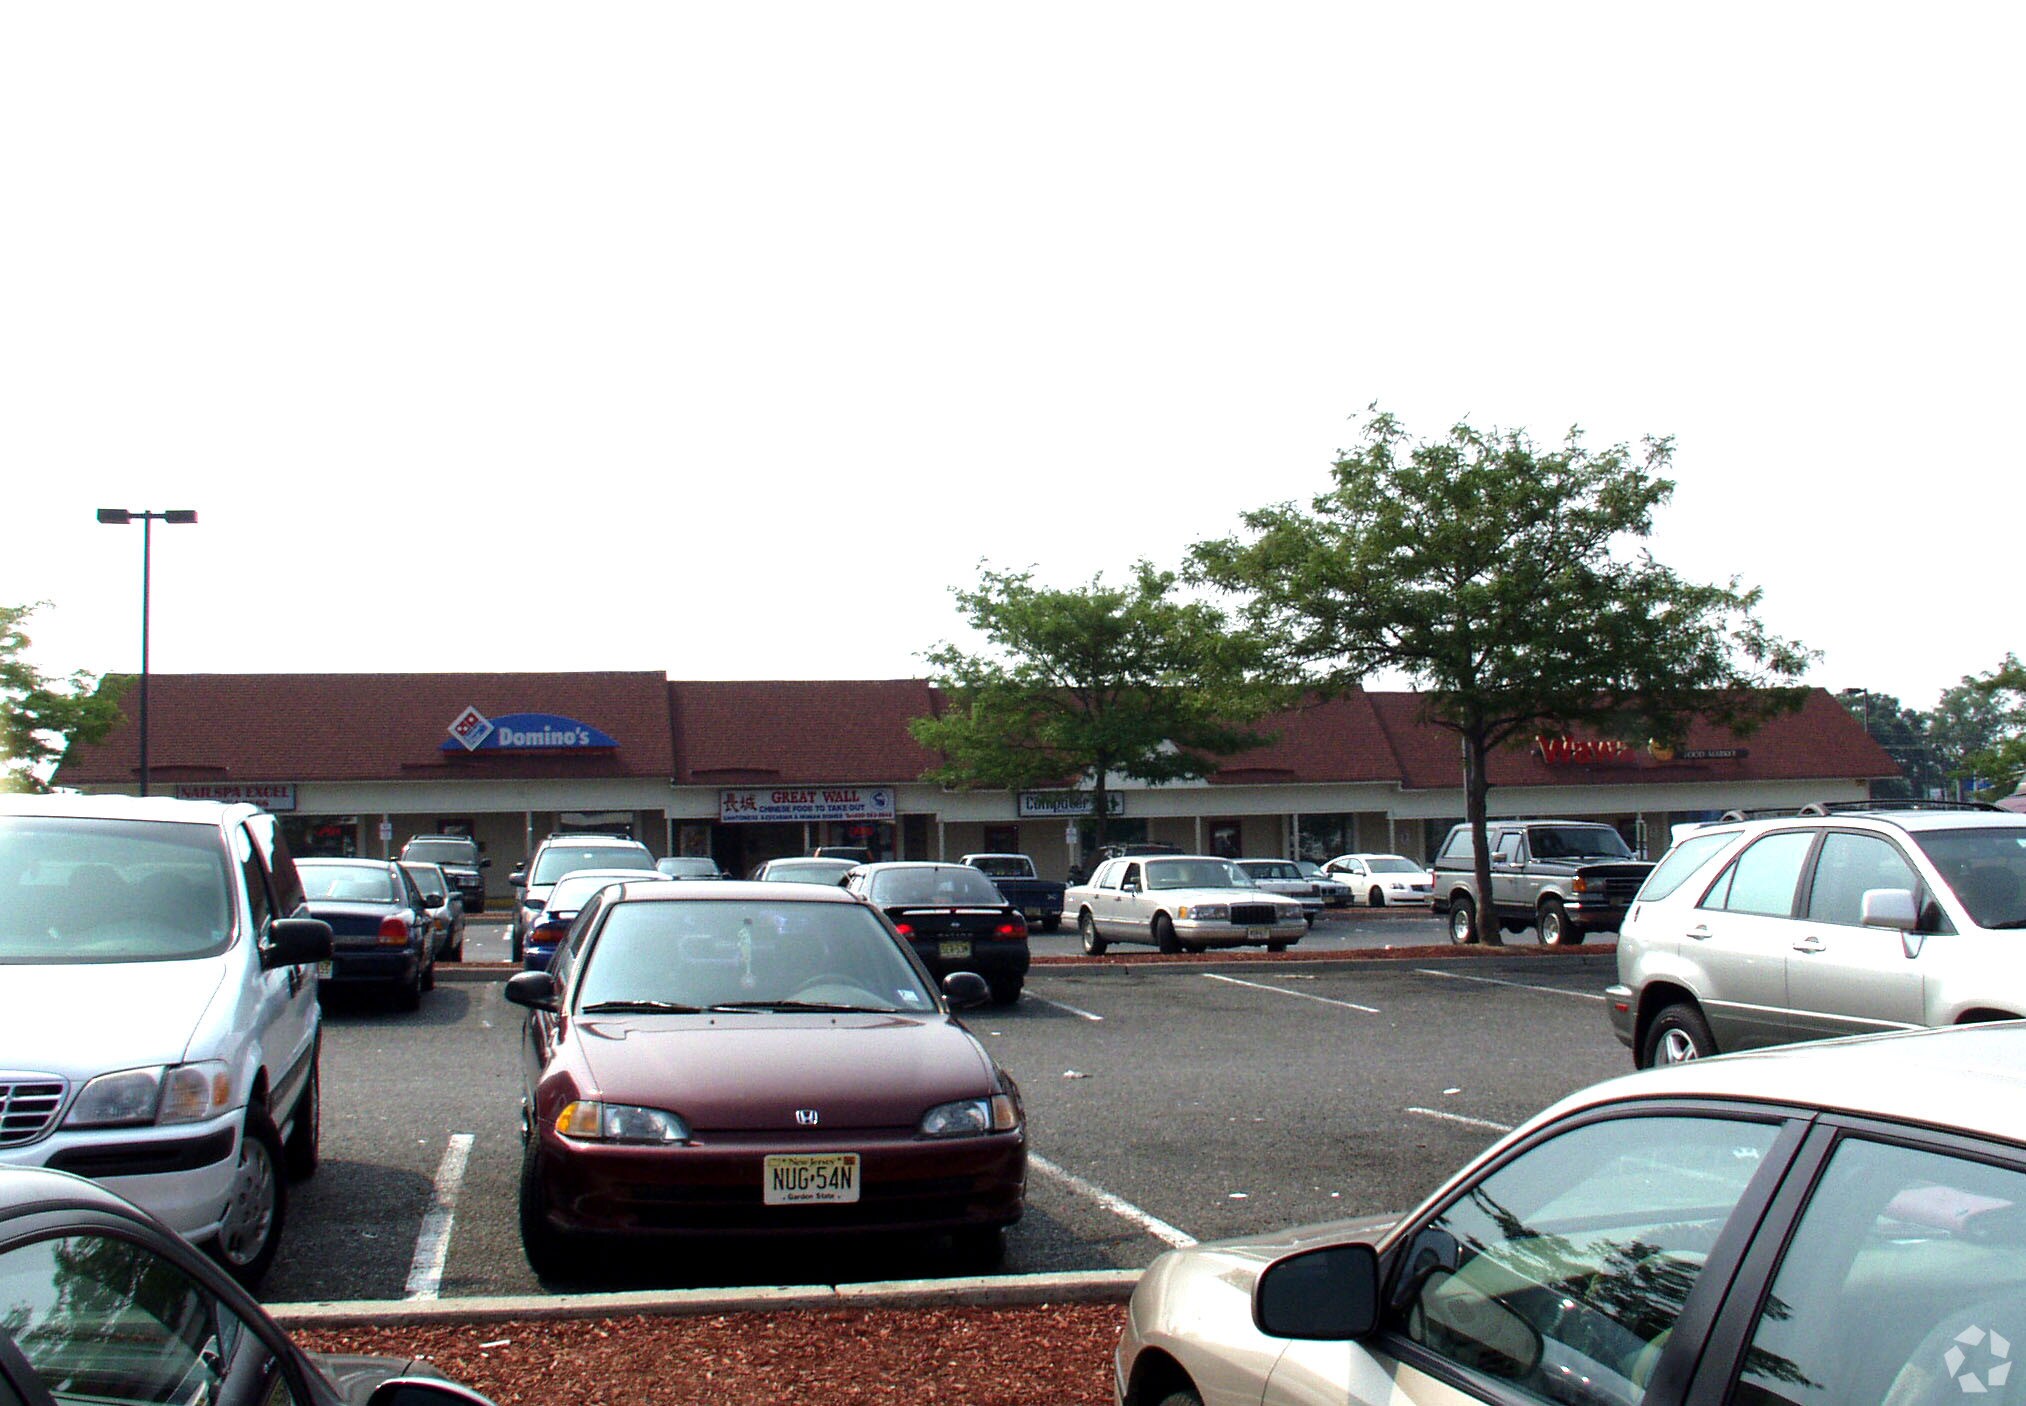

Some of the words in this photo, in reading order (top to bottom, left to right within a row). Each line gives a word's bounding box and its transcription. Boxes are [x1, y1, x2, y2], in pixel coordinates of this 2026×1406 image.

[498, 725, 590, 745] Domino's
[246, 786, 289, 798] EXCEL
[771, 791, 817, 803] GREAT
[822, 791, 860, 803] WALL
[759, 805, 792, 813] CHINESE
[793, 805, 813, 813] FOOD
[815, 804, 825, 812] TO
[828, 804, 847, 812] TAKE
[848, 803, 865, 811] OUT
[816, 1192, 835, 1200] State
